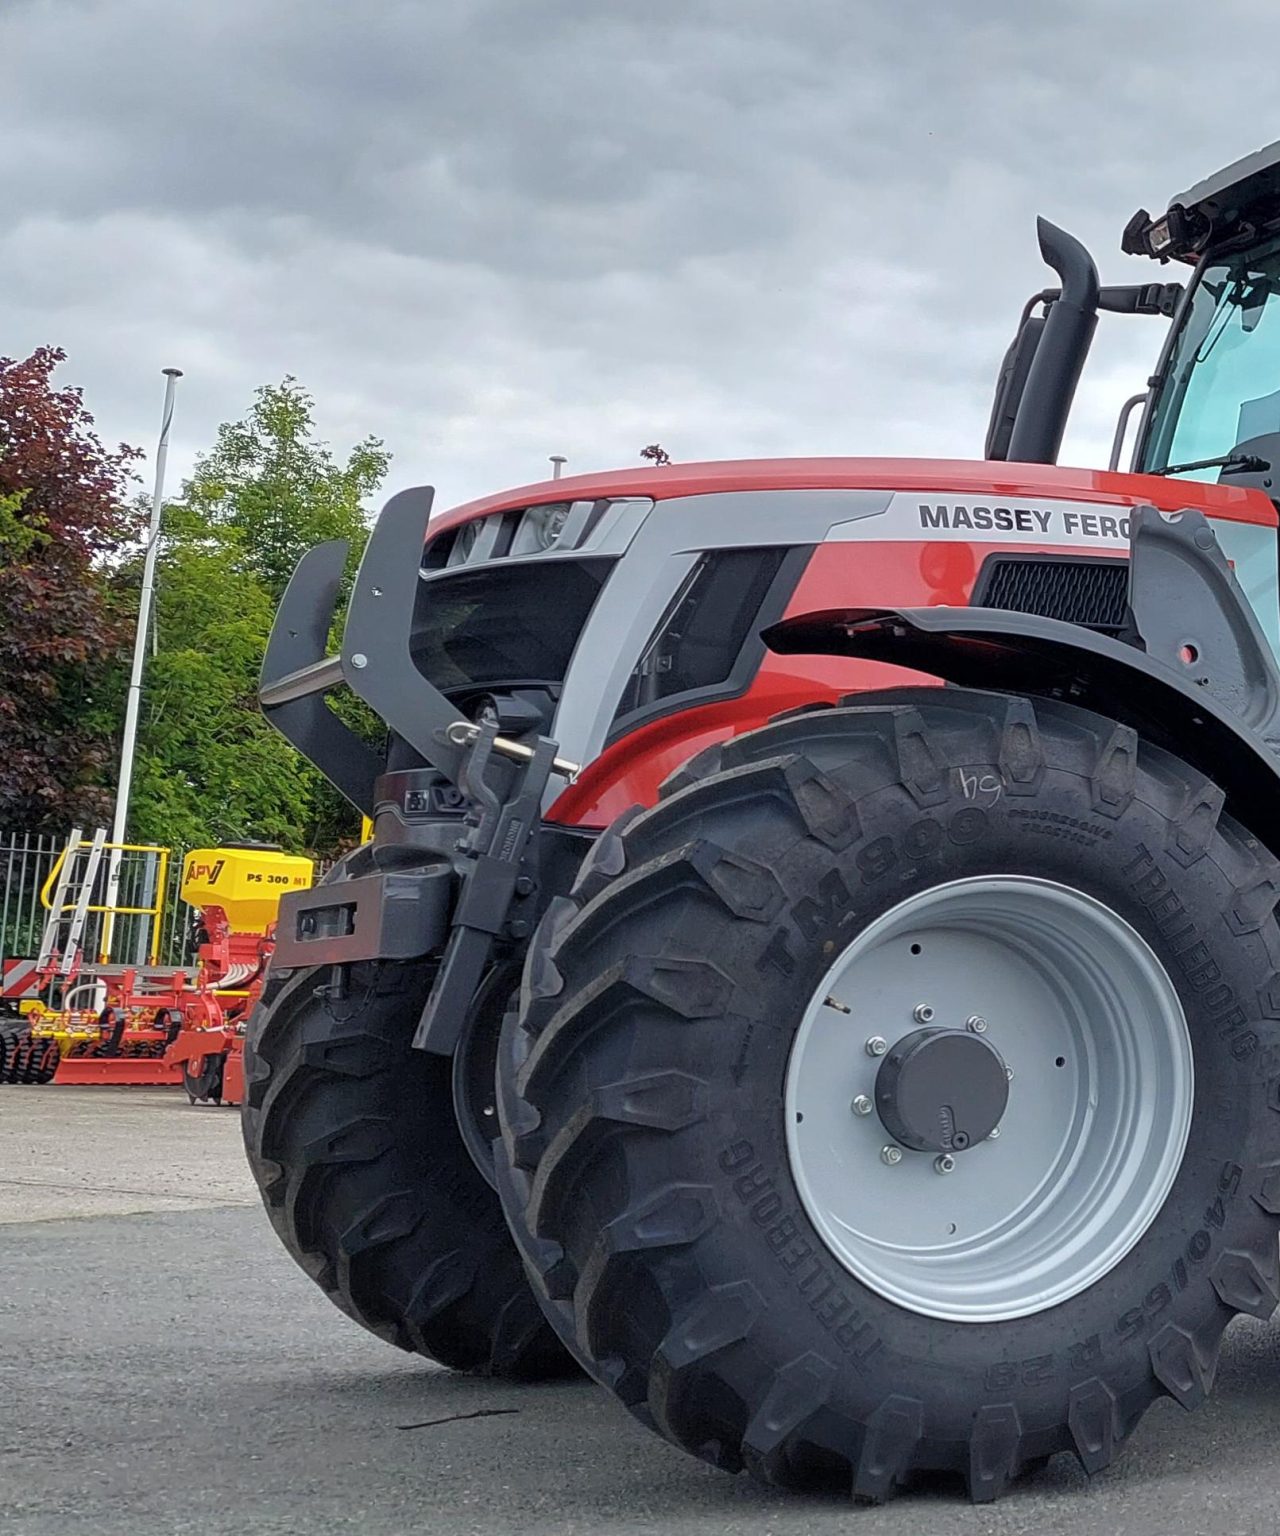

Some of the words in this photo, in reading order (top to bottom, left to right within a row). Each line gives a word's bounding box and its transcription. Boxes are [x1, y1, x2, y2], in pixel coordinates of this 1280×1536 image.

[918, 505, 1052, 533] MASSEY
[246, 873, 262, 882] PS
[267, 875, 289, 884] 300
[1122, 842, 1258, 1062] TRELLEBORG
[718, 1139, 884, 1377] TRELLEBORG
[1114, 1160, 1243, 1345] 540/65
